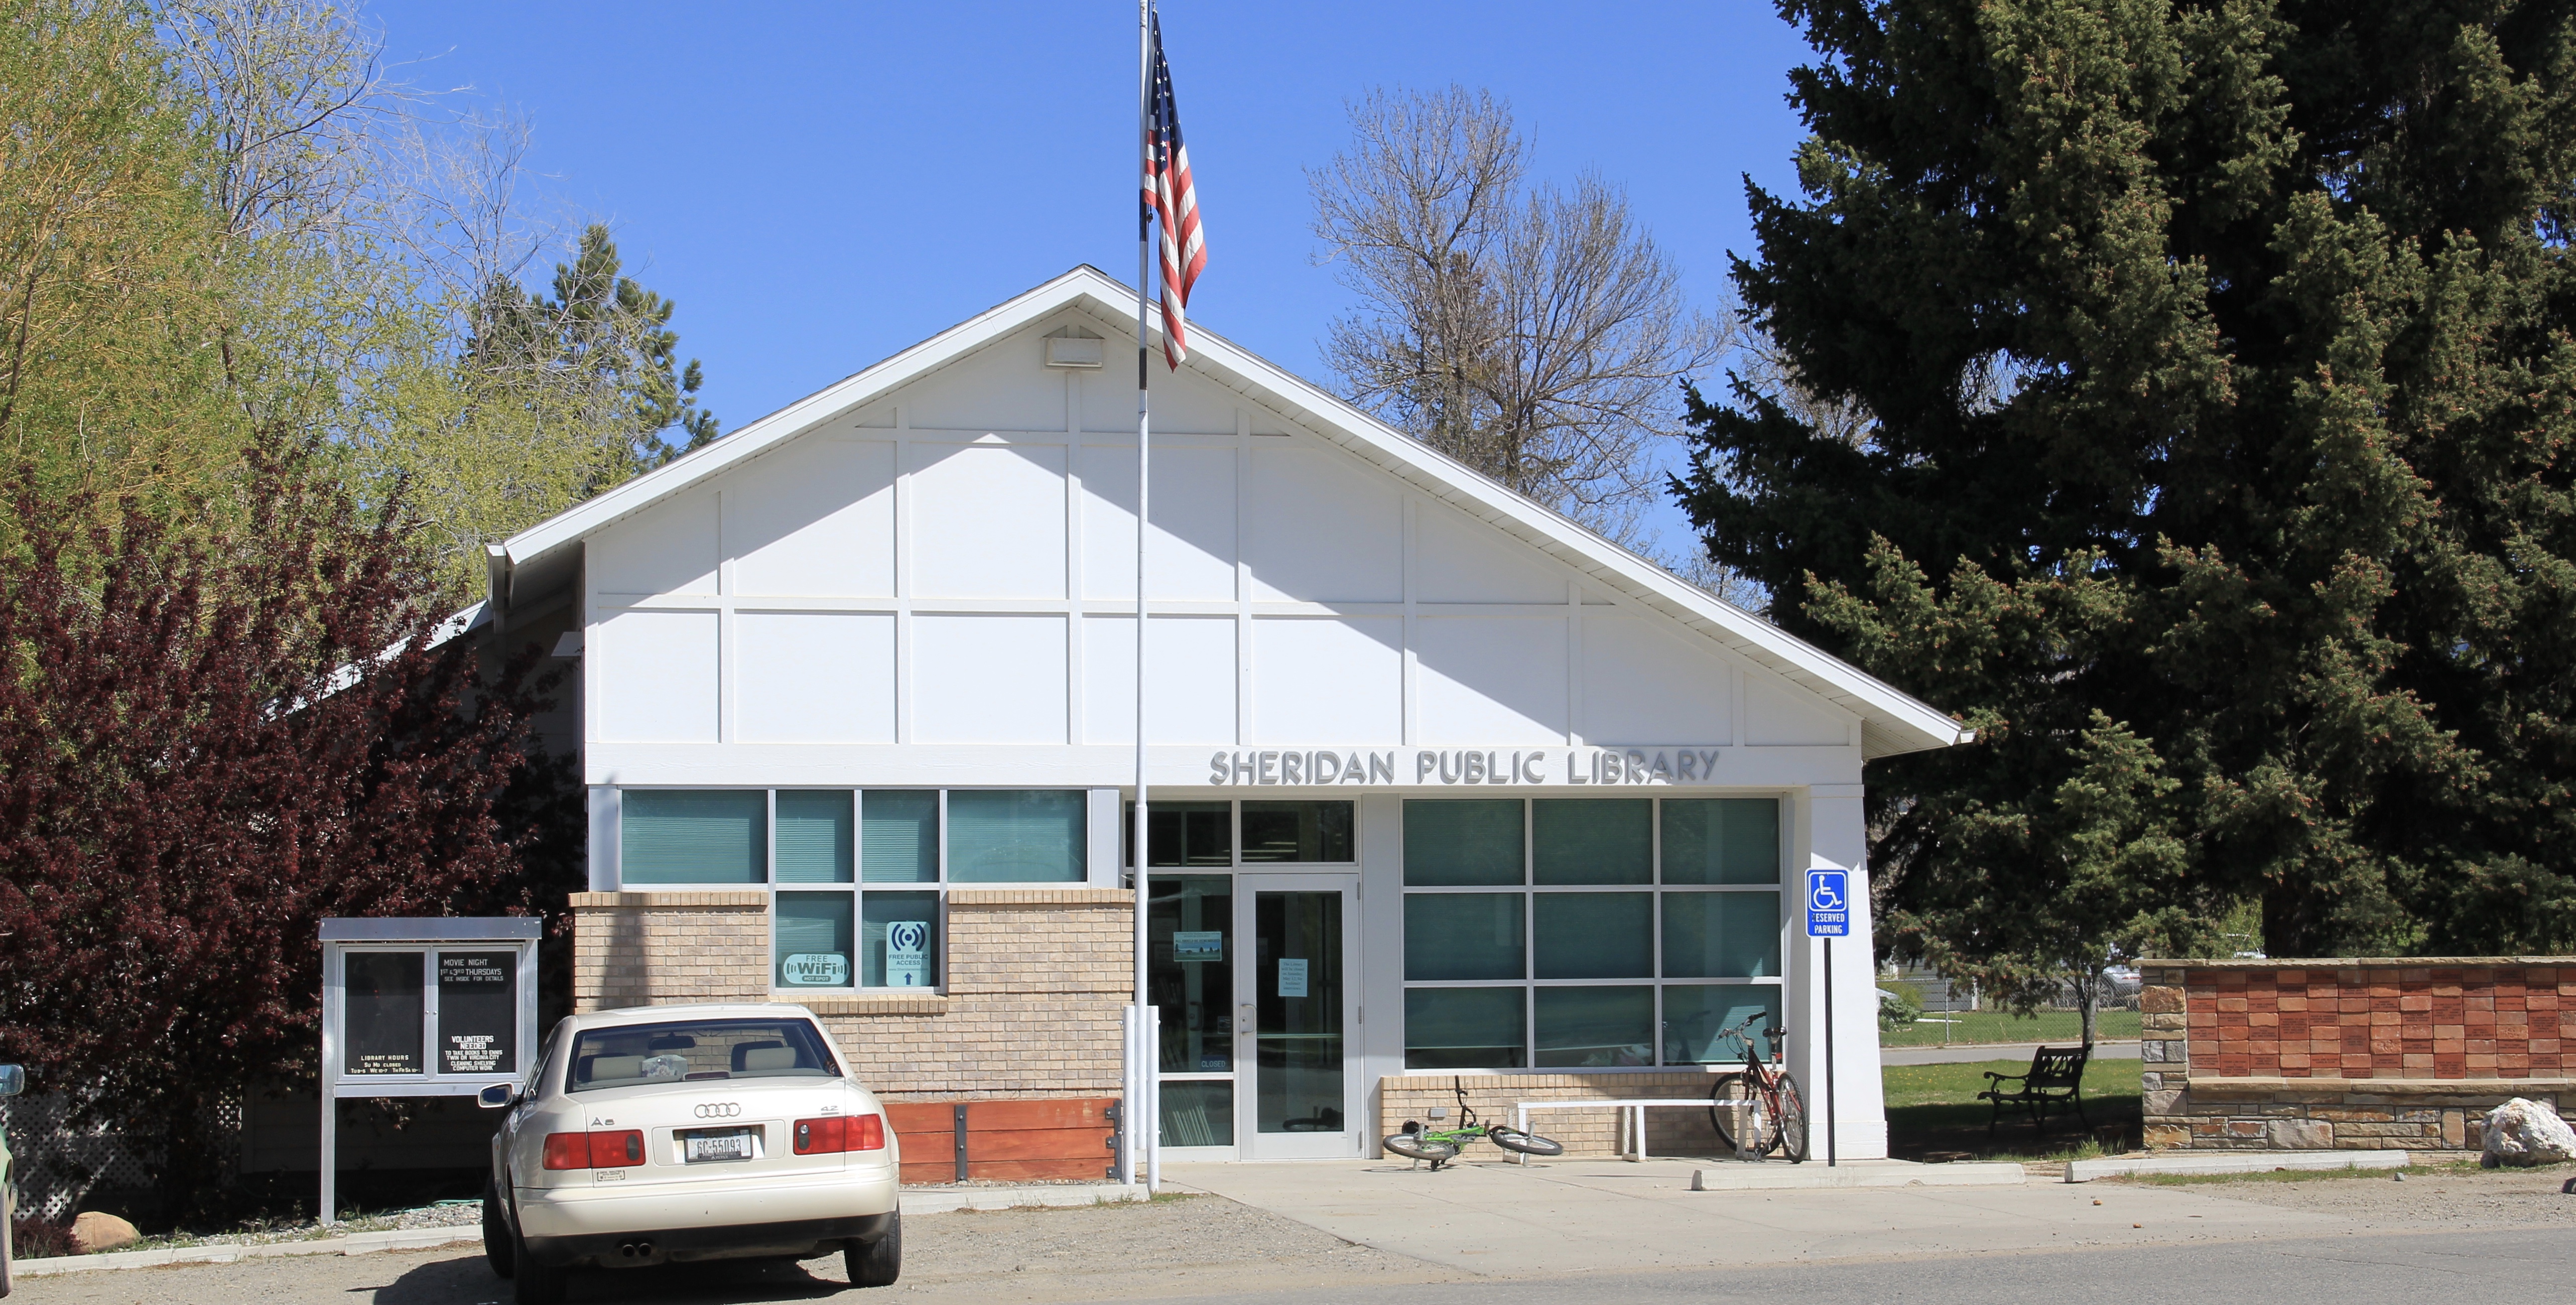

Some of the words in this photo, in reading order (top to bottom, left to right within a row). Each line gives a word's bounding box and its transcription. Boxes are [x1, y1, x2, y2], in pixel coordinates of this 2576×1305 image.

[1209, 751, 1394, 786] SHERIDAN
[1416, 751, 1545, 785] PUBLIC
[1568, 750, 1719, 785] LIBRARY
[1815, 925, 1842, 934] PARKING
[797, 962, 837, 974] WiFi
[591, 1117, 615, 1126] A8
